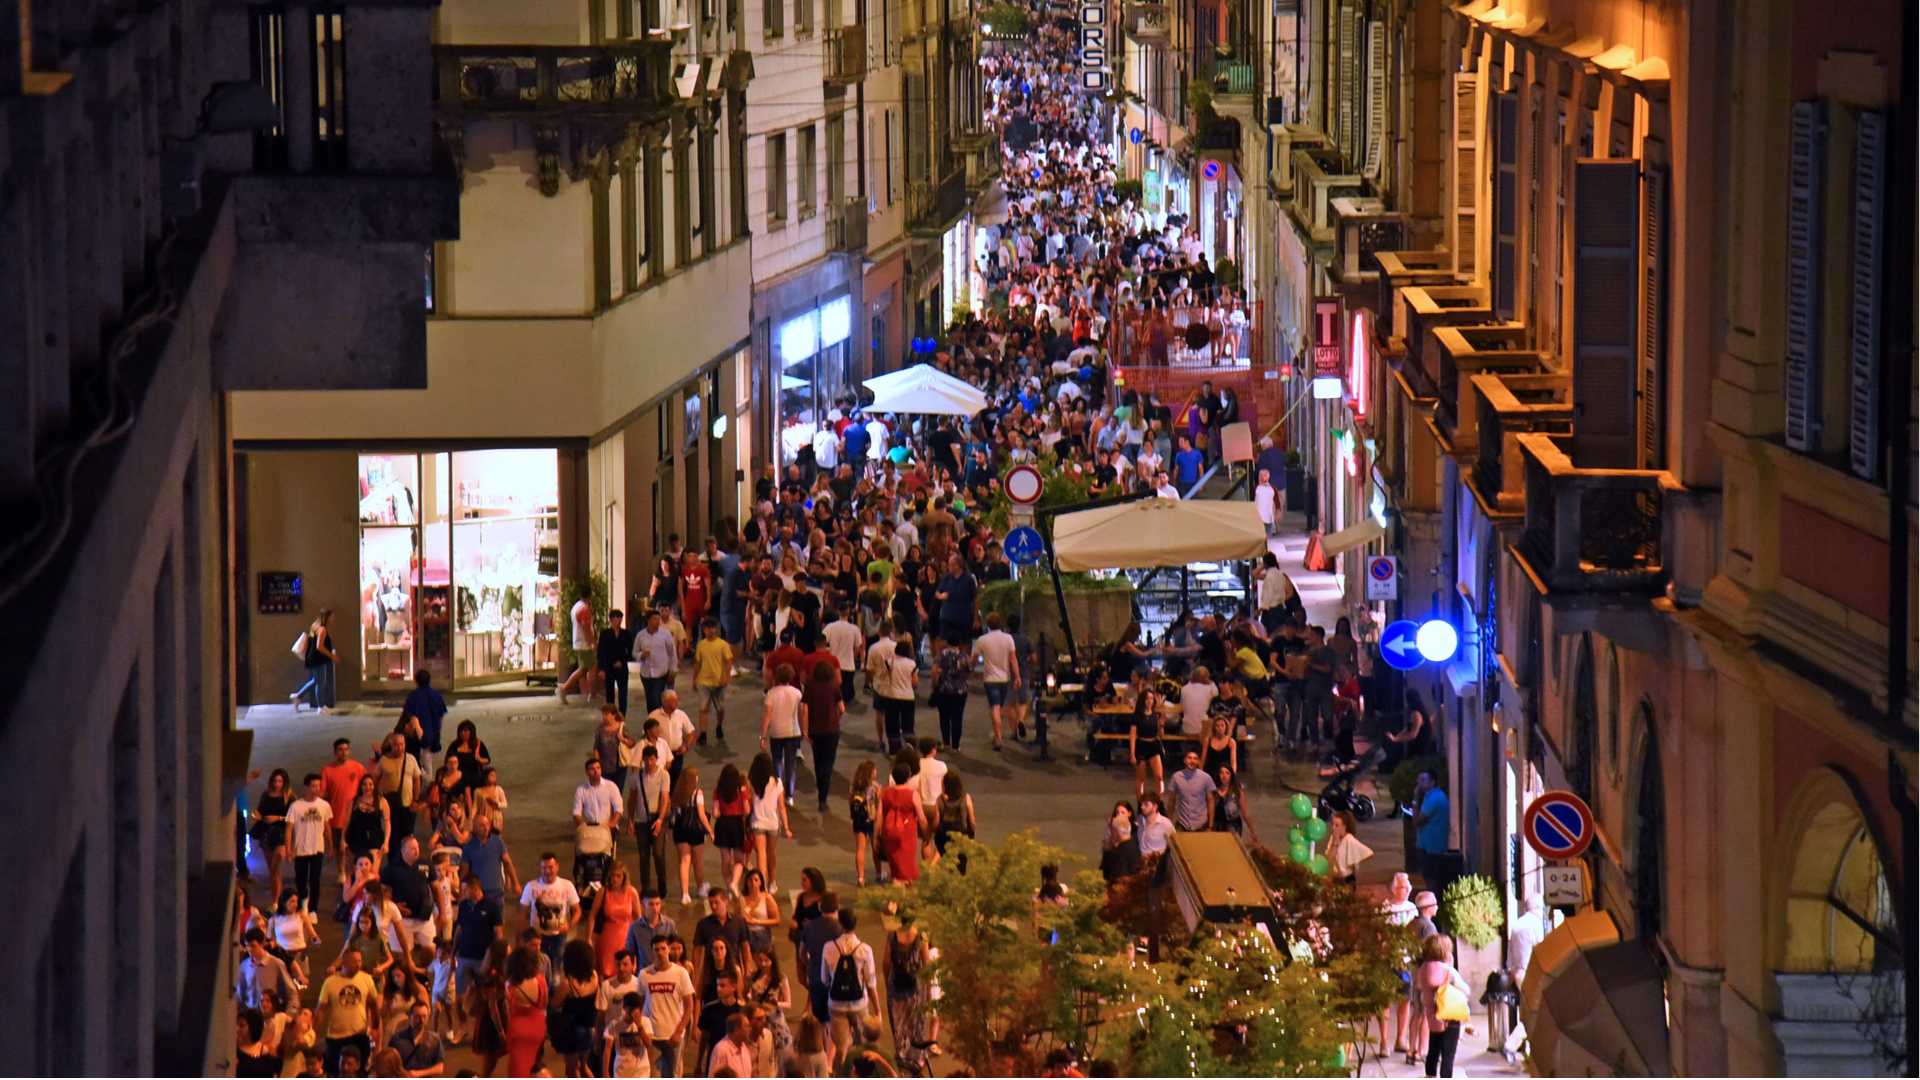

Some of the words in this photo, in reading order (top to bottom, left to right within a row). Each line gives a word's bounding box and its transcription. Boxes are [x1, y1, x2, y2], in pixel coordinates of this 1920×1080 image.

[1082, 0, 1104, 89] ORSO
[1317, 303, 1337, 346] T
[1316, 348, 1338, 357] LOTTO
